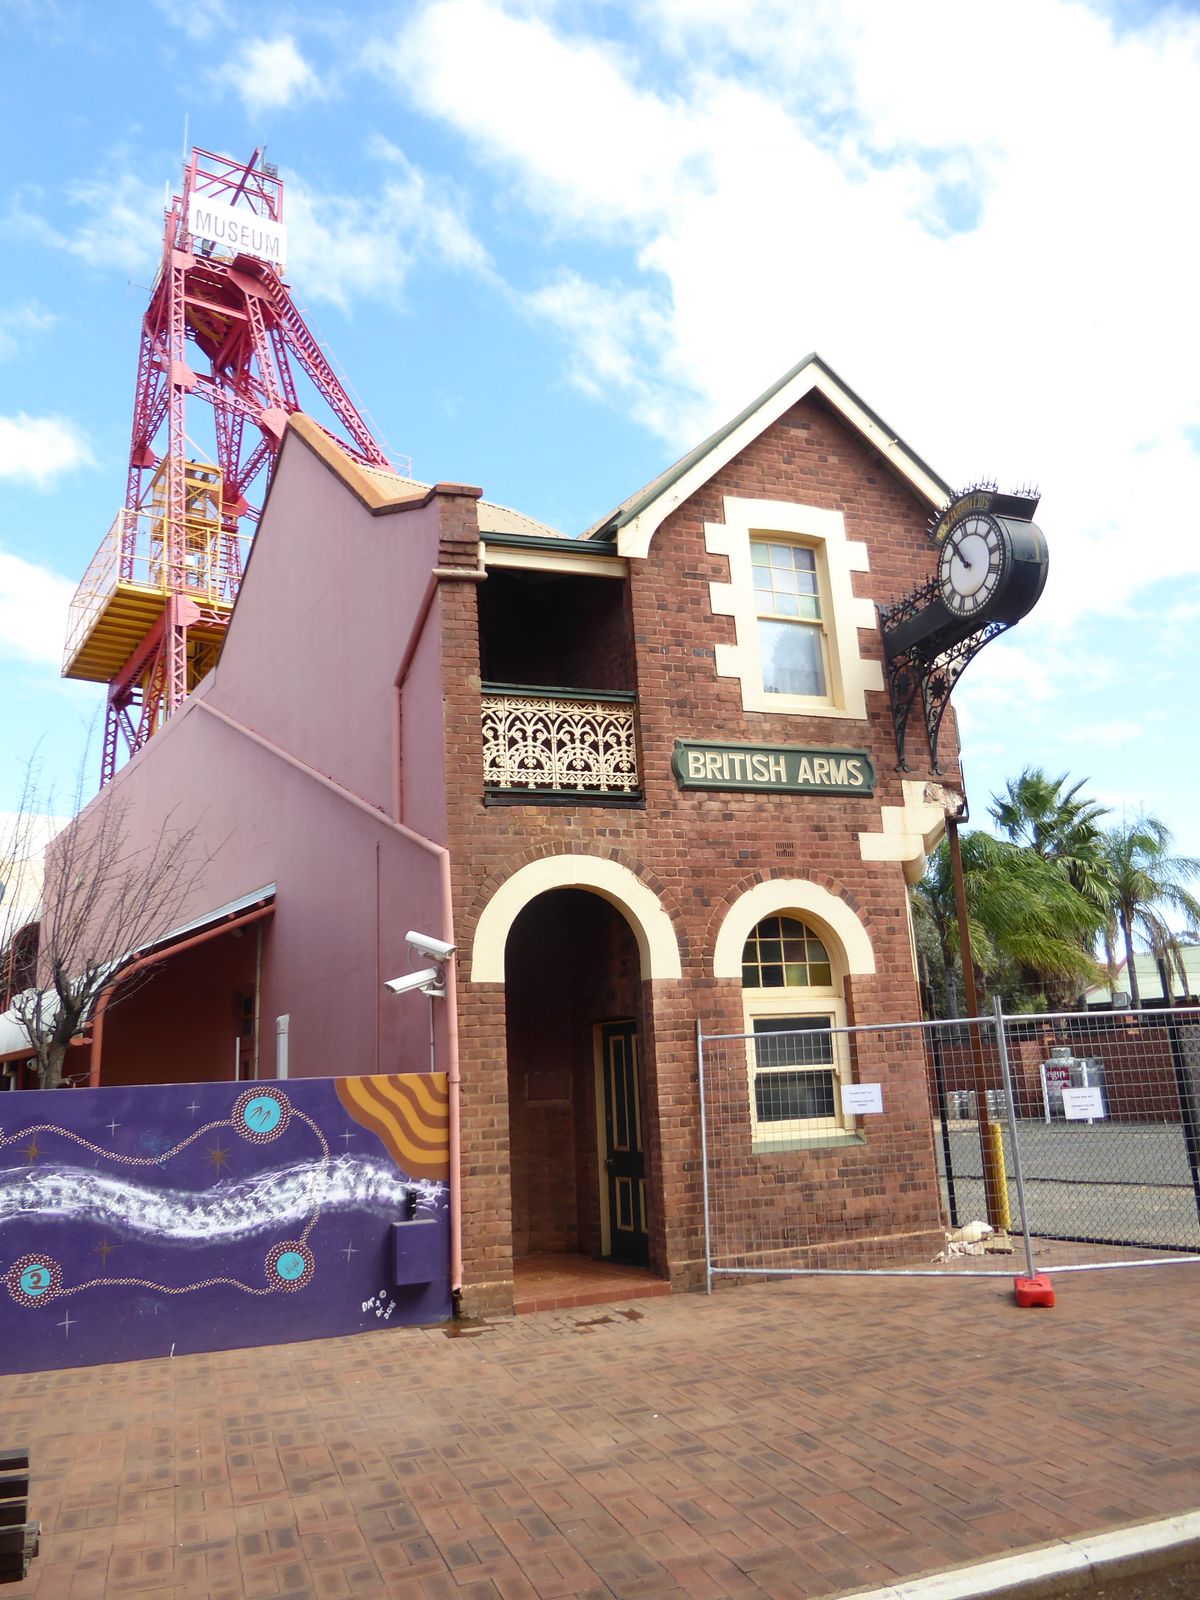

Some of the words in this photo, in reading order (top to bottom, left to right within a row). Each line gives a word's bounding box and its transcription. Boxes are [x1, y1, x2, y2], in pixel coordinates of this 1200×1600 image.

[196, 209, 279, 257] MUSEUM
[687, 751, 787, 783] BRITISH
[797, 756, 864, 786] ARMS
